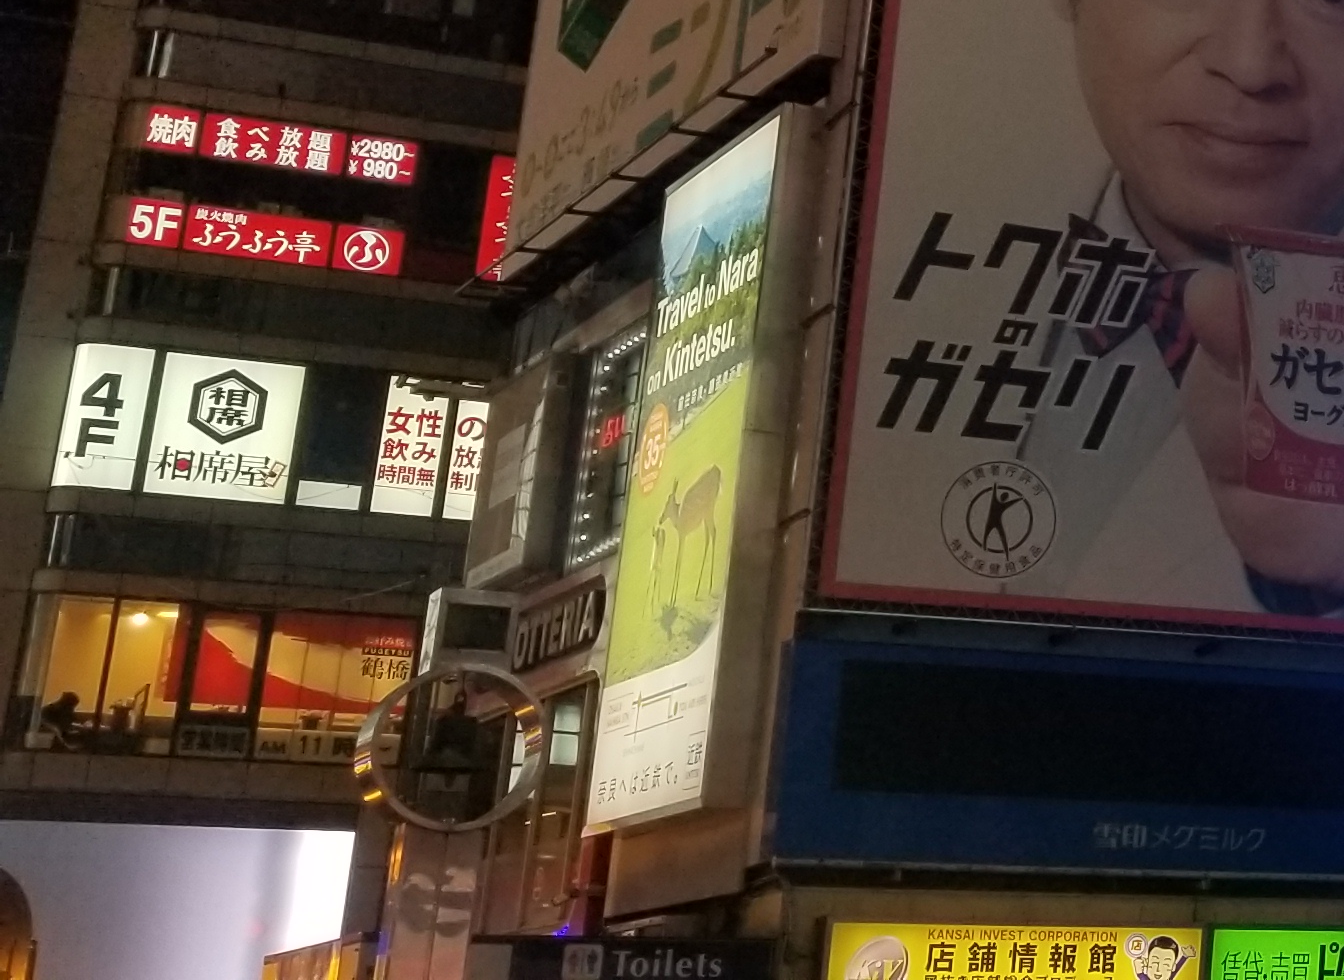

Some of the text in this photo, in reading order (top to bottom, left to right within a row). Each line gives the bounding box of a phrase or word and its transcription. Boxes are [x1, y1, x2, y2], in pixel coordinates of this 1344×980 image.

[146, 112, 199, 147] 焼肉
[216, 117, 333, 151] 食べ放題
[213, 138, 330, 171] 飲み放題
[129, 204, 183, 241] 5F
[194, 208, 248, 226] 炭火焼肉
[192, 222, 321, 263] ふうふう亭
[656, 248, 760, 338] Travel to Nara
[992, 318, 1039, 347] の
[646, 371, 662, 397] on
[662, 318, 737, 388] Kintetsu.
[876, 339, 1136, 451] ガセリ
[152, 444, 271, 487] 相席屋
[361, 657, 410, 680] 鶴橋
[259, 740, 287, 755] AM
[1093, 822, 1268, 854] 雪印メグミルク
[927, 928, 1118, 942] KANSAI INVEST CORPORATION
[611, 947, 723, 980] Toilets
[925, 941, 1117, 974] 店舗情報館
